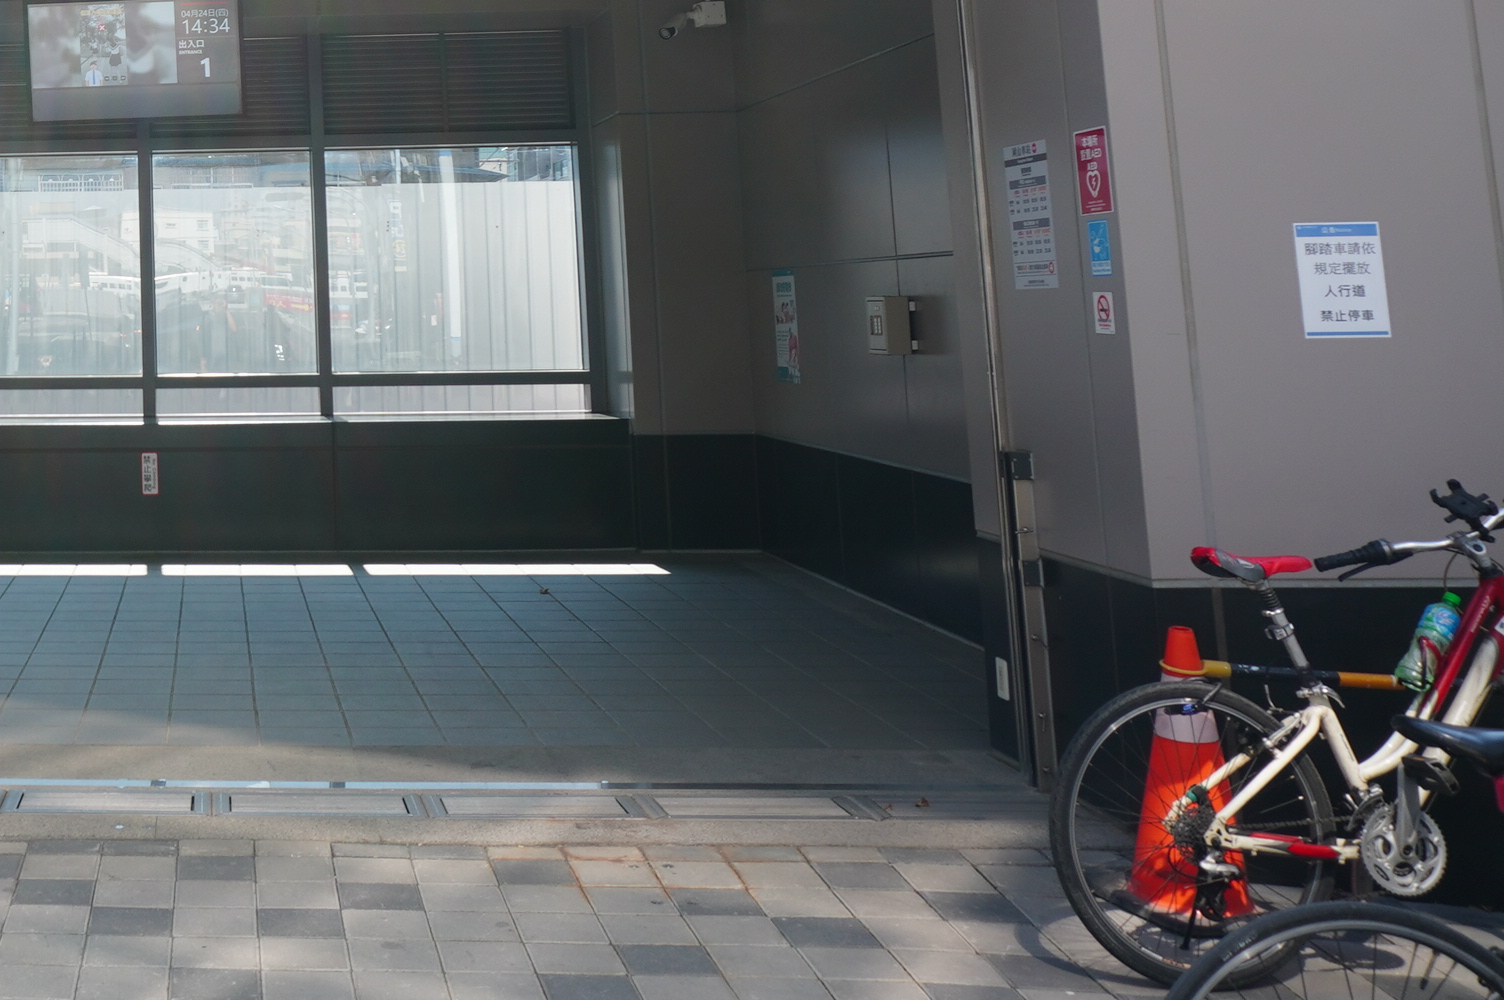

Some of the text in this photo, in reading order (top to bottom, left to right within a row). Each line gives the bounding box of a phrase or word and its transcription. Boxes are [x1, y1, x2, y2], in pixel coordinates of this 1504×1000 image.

[182, 18, 231, 34] 14:34
[178, 40, 205, 49] 出入口
[200, 57, 211, 78] 1
[1304, 242, 1377, 256] 腳踏車請依
[1314, 261, 1372, 275] 規定擺放
[1324, 284, 1367, 298] 人行道
[1320, 309, 1375, 322] 禁止停車
